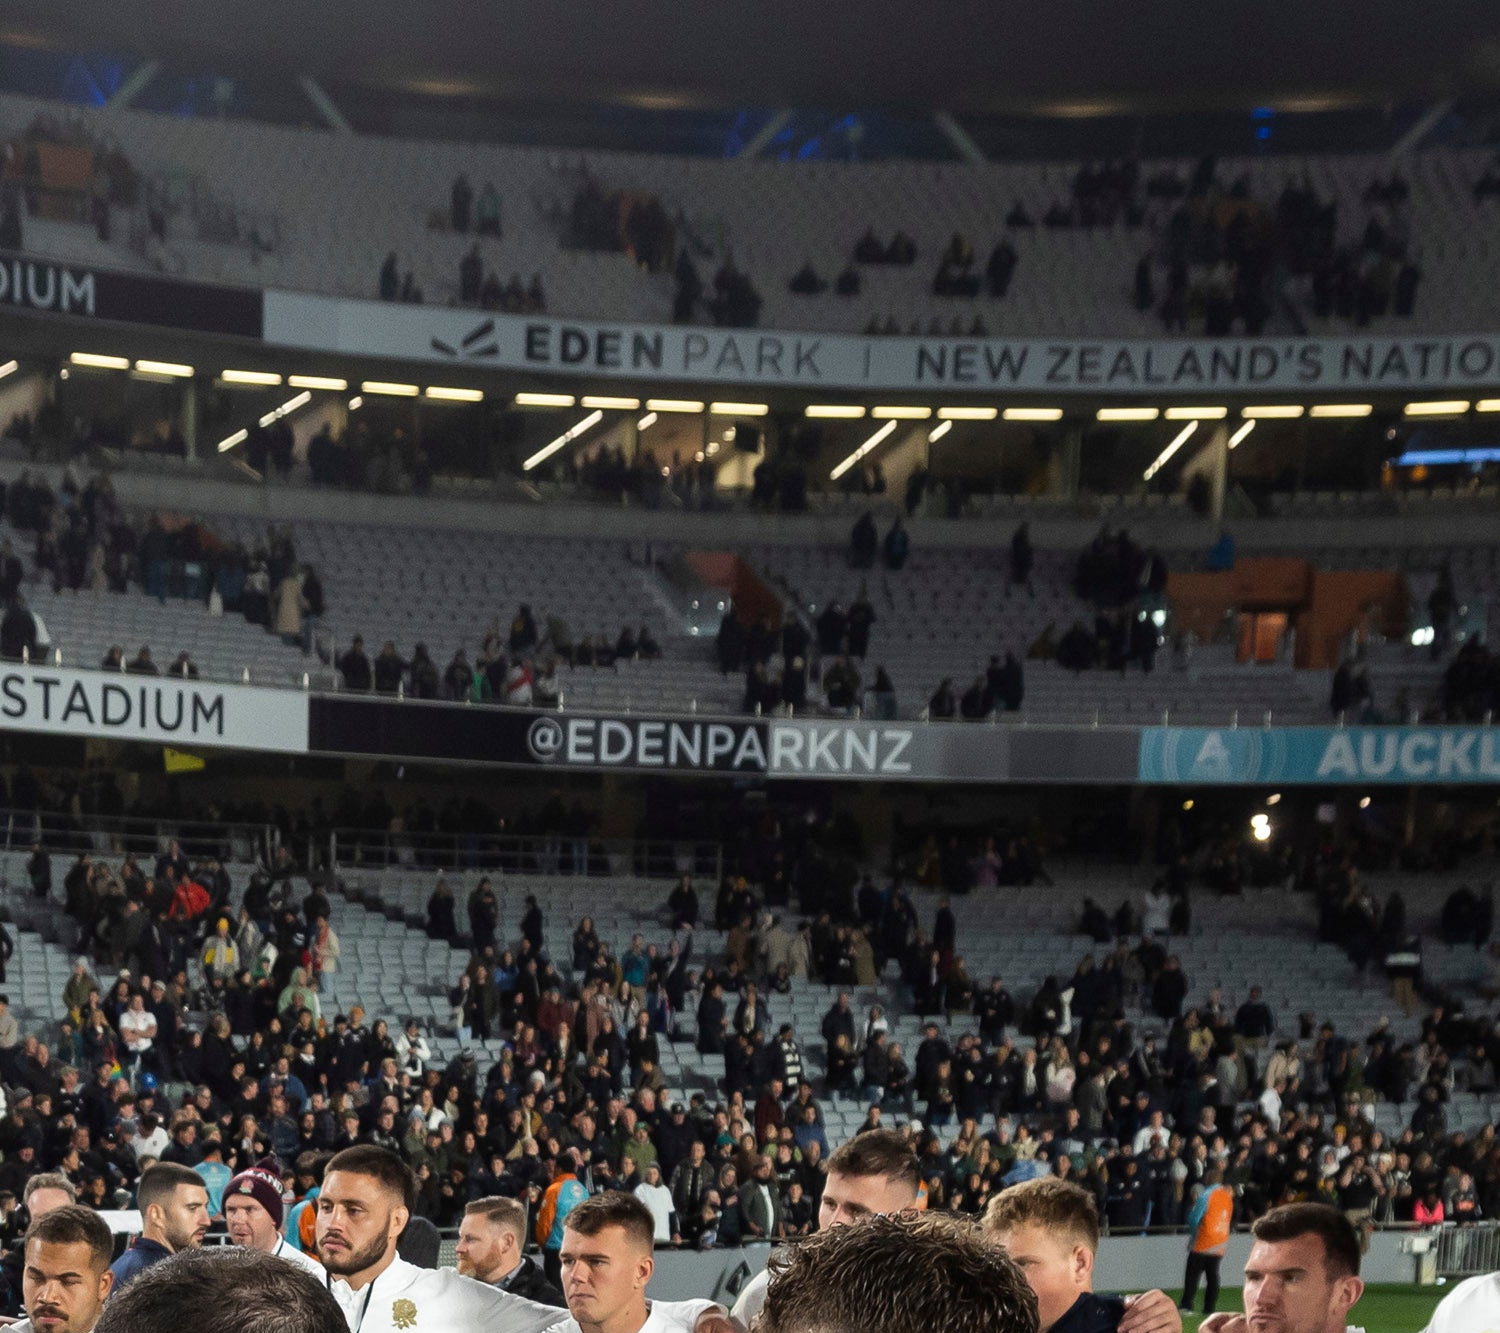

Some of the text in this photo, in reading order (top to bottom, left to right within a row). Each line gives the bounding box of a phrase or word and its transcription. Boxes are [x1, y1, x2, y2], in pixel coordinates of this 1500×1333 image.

[525, 326, 822, 376] EDEN PARK
[916, 345, 1029, 382] NEW
[1046, 344, 1323, 384] ZEALAND'S
[2, 675, 223, 736] STADIUM
[527, 716, 912, 772] @EDENPARKNZ
